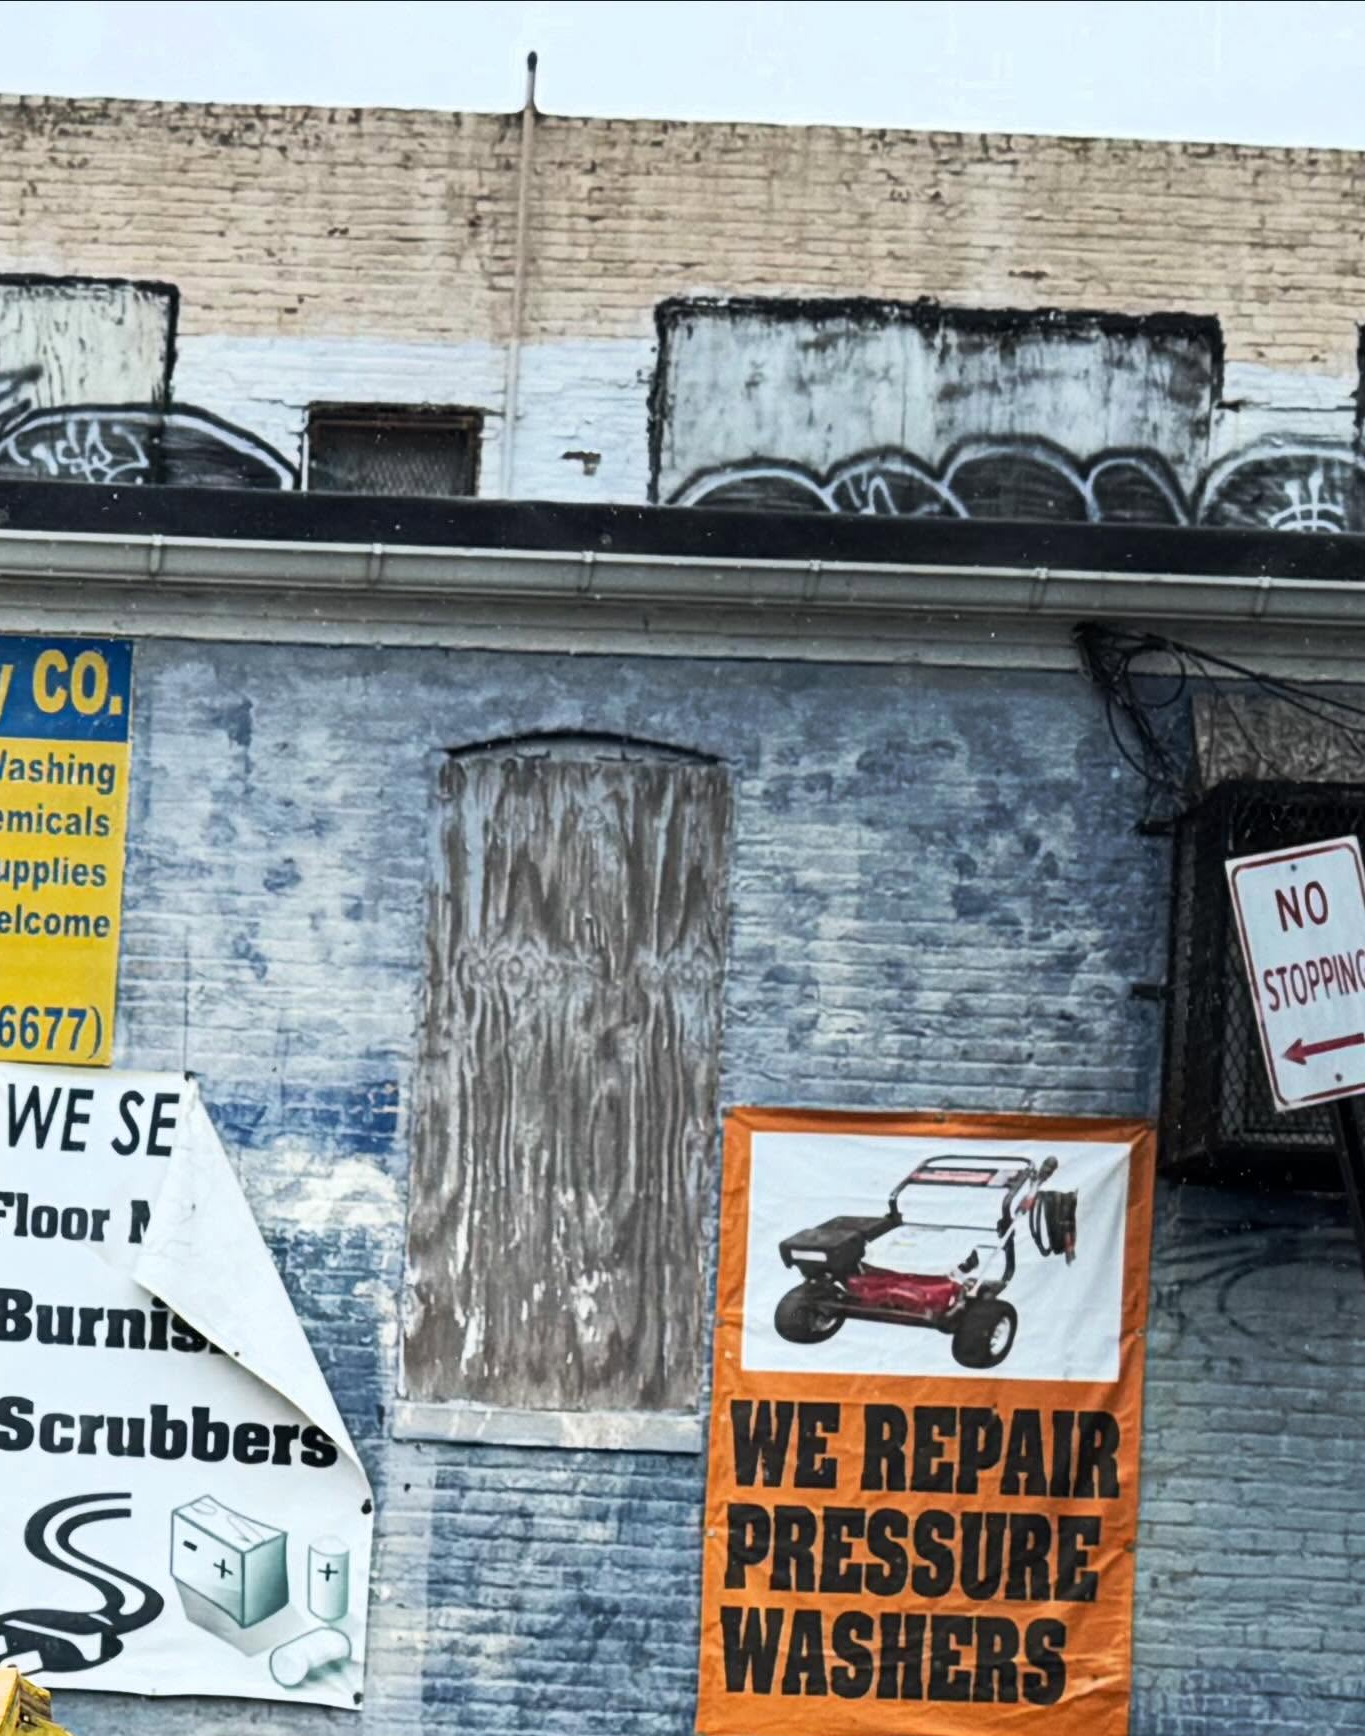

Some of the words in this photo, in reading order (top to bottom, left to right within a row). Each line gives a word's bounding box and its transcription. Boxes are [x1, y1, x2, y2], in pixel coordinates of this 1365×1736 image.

[32, 648, 123, 716] CO.
[1274, 881, 1329, 932] NO
[8, 1083, 94, 1153] WE
[730, 1399, 841, 1489] WE
[861, 1403, 1120, 1499] REPAIR
[724, 1502, 1101, 1604] PRESSURE
[720, 1606, 1066, 1706] WASHERS
